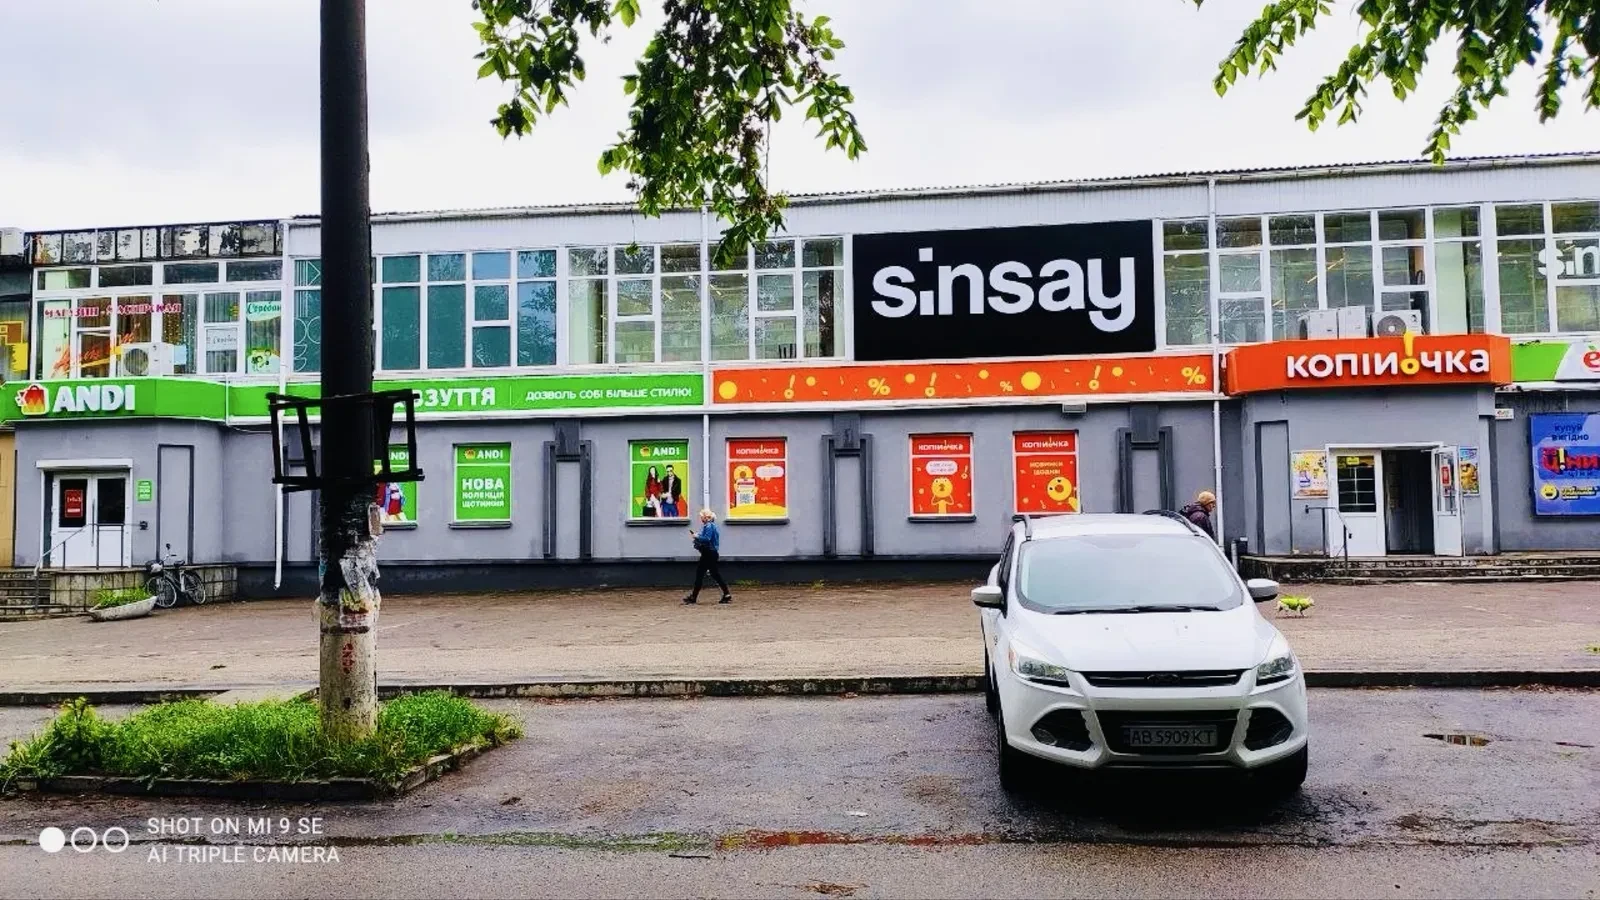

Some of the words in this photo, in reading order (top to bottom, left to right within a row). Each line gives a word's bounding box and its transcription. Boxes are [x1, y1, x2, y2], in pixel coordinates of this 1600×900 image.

[871, 247, 1136, 332] sinsay
[53, 385, 136, 413] ANDI
[525, 391, 576, 401] ДОЗВОЛЬ
[579, 390, 604, 399] СОБІ
[606, 389, 648, 399] БІЛЬШЕ
[650, 388, 692, 398] СТИЛЮ!
[390, 451, 409, 461] NDI
[477, 450, 504, 459] ANDI
[653, 447, 680, 456] ANDI
[462, 478, 504, 490] НОВА
[1155, 730, 1190, 745] 5909
